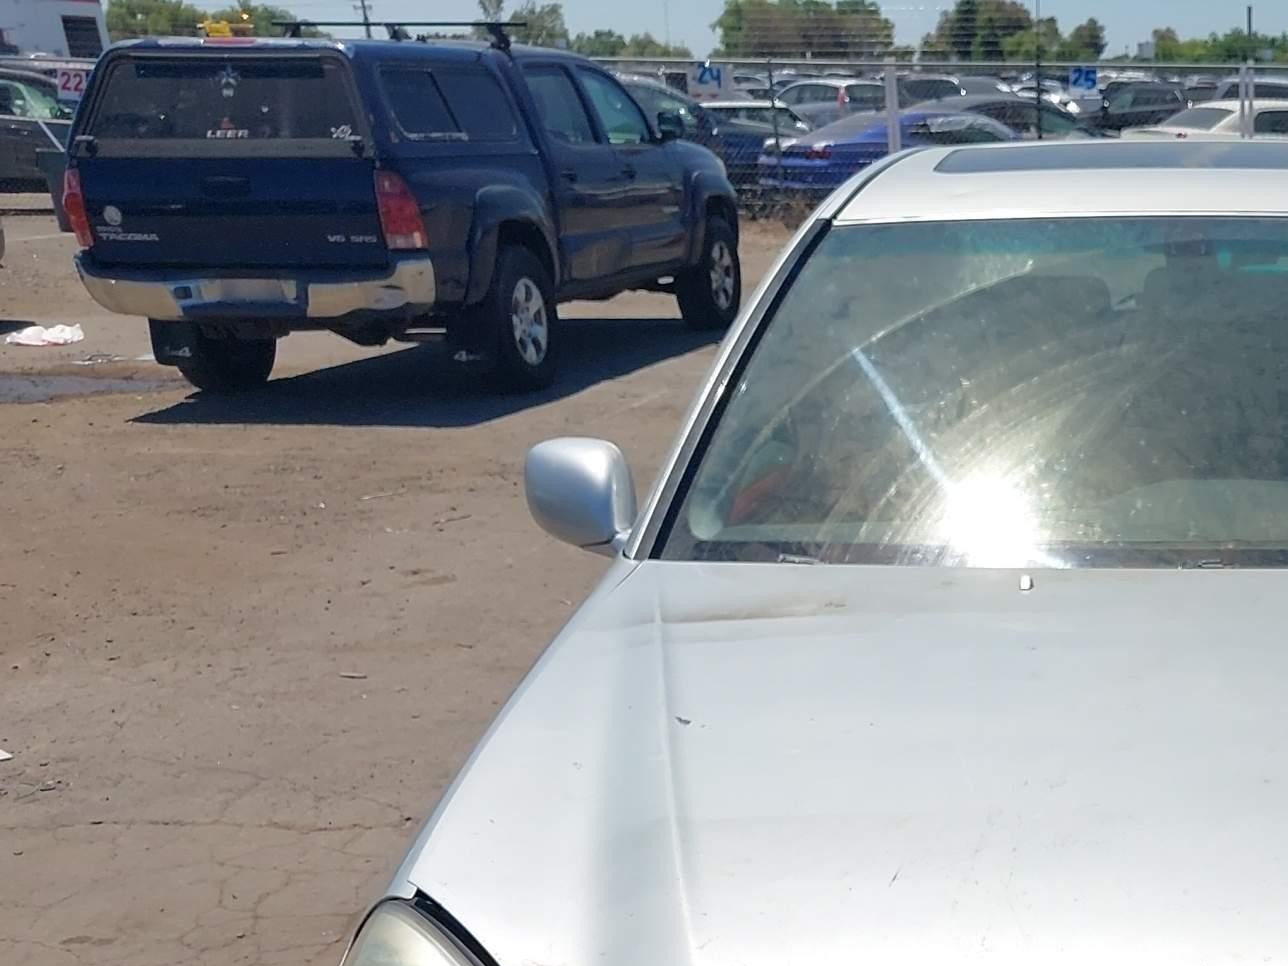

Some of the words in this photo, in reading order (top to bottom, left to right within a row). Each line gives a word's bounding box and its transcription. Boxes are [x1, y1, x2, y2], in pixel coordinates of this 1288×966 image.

[60, 71, 83, 91] 22
[1072, 66, 1097, 90] 25
[206, 129, 249, 139] LEER
[98, 232, 159, 241] TACOMA
